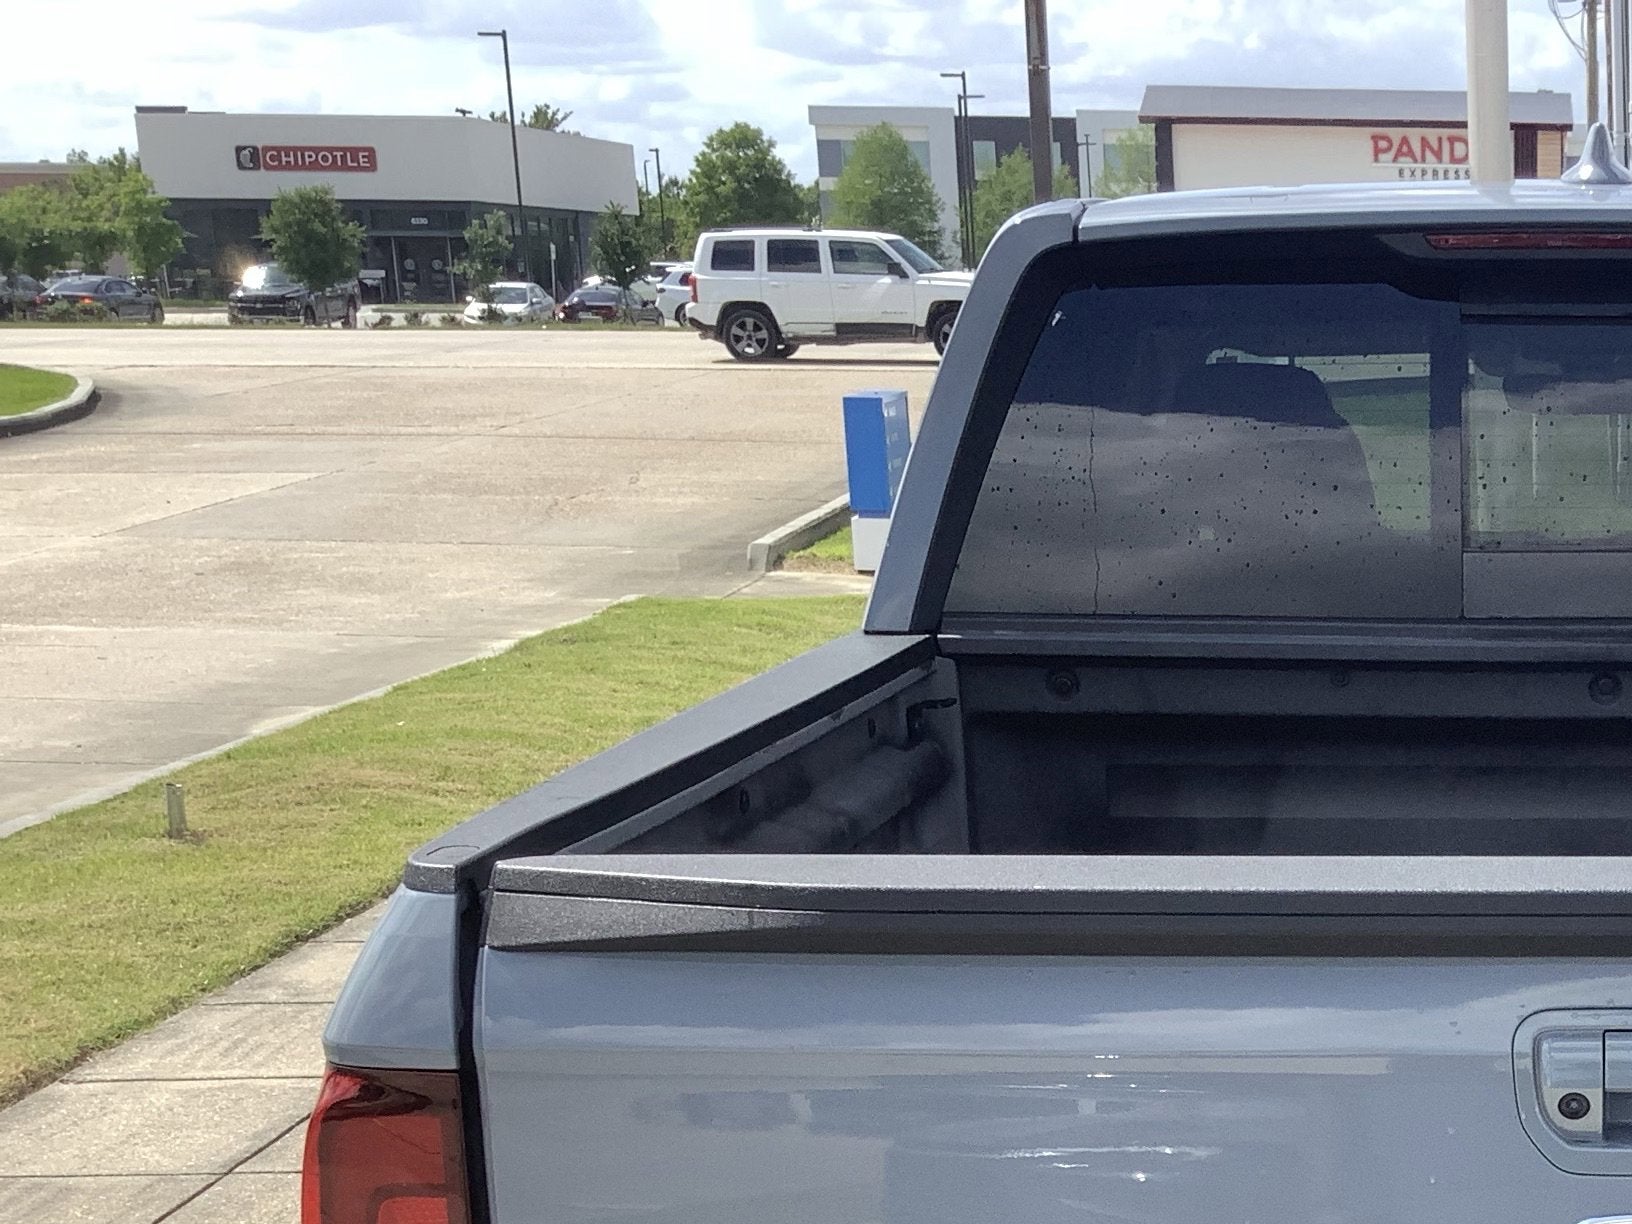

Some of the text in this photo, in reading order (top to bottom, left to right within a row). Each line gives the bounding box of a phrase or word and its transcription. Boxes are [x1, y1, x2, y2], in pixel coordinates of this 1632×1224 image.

[1371, 135, 1469, 164] PAND
[265, 150, 371, 167] CHIPOTLE
[1398, 167, 1471, 180] EXPRESS
